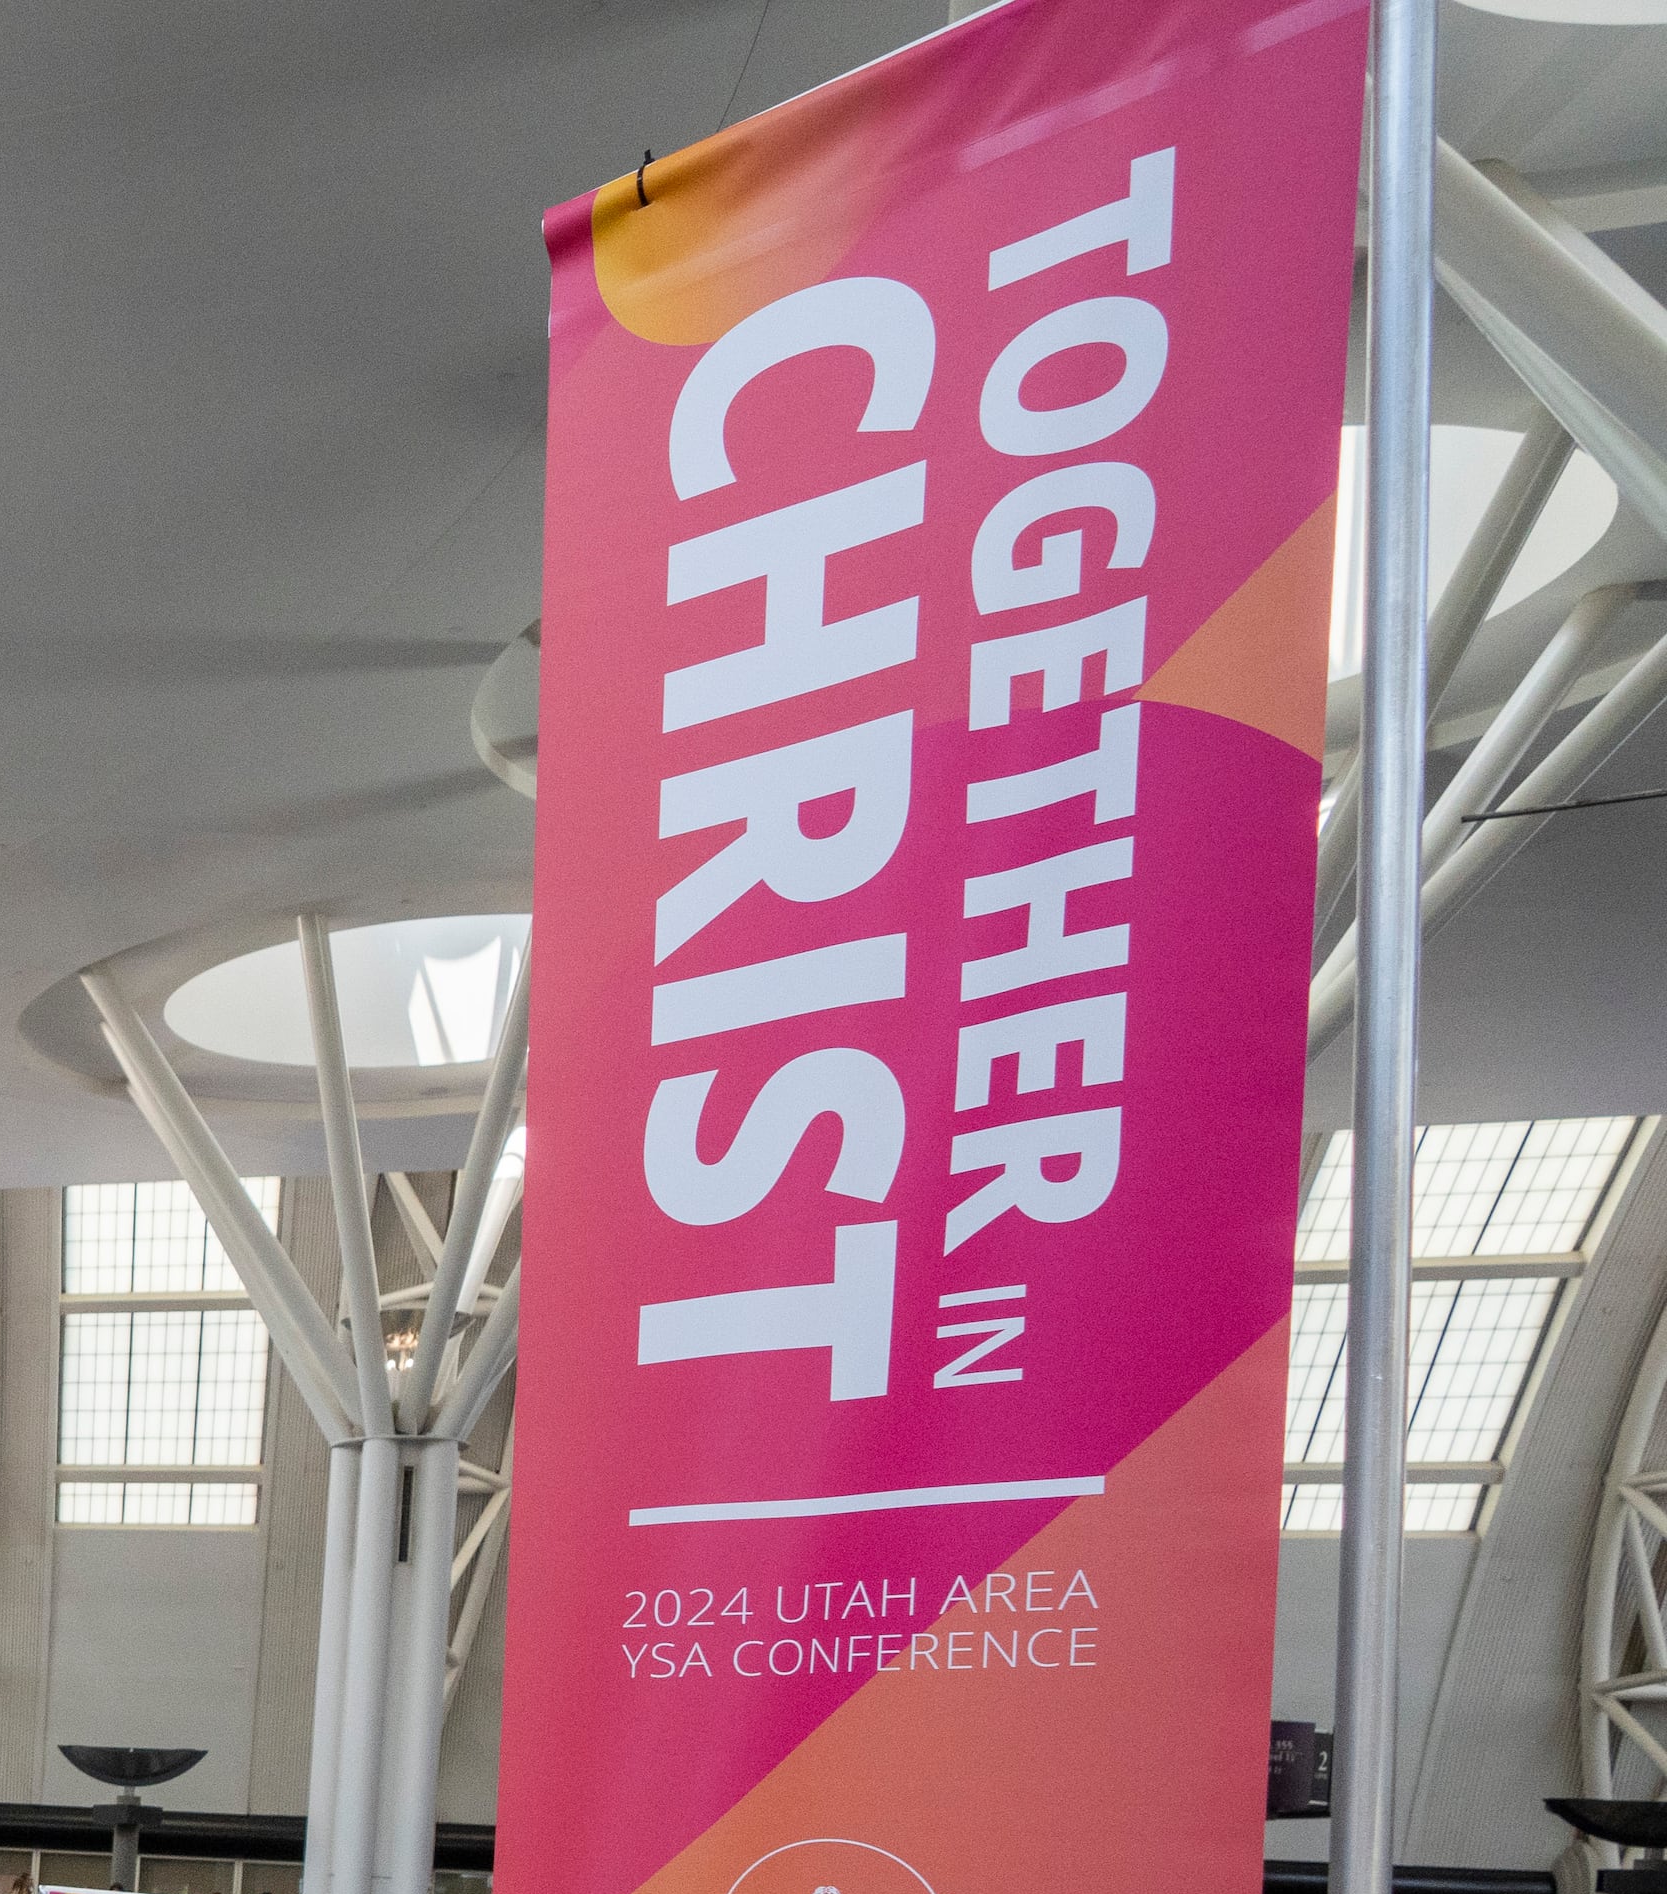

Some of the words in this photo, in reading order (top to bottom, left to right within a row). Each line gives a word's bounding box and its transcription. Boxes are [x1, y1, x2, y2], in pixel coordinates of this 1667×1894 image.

[944, 146, 1177, 1258] TOGETHER
[638, 275, 936, 1402] CHRIST
[933, 1283, 1027, 1389] IN
[622, 1588, 753, 1628] 2024
[774, 1575, 916, 1625] UTAH
[943, 1569, 1099, 1615] AREA
[622, 1641, 714, 1680] YSA
[732, 1626, 1098, 1676] CONFERENCE
